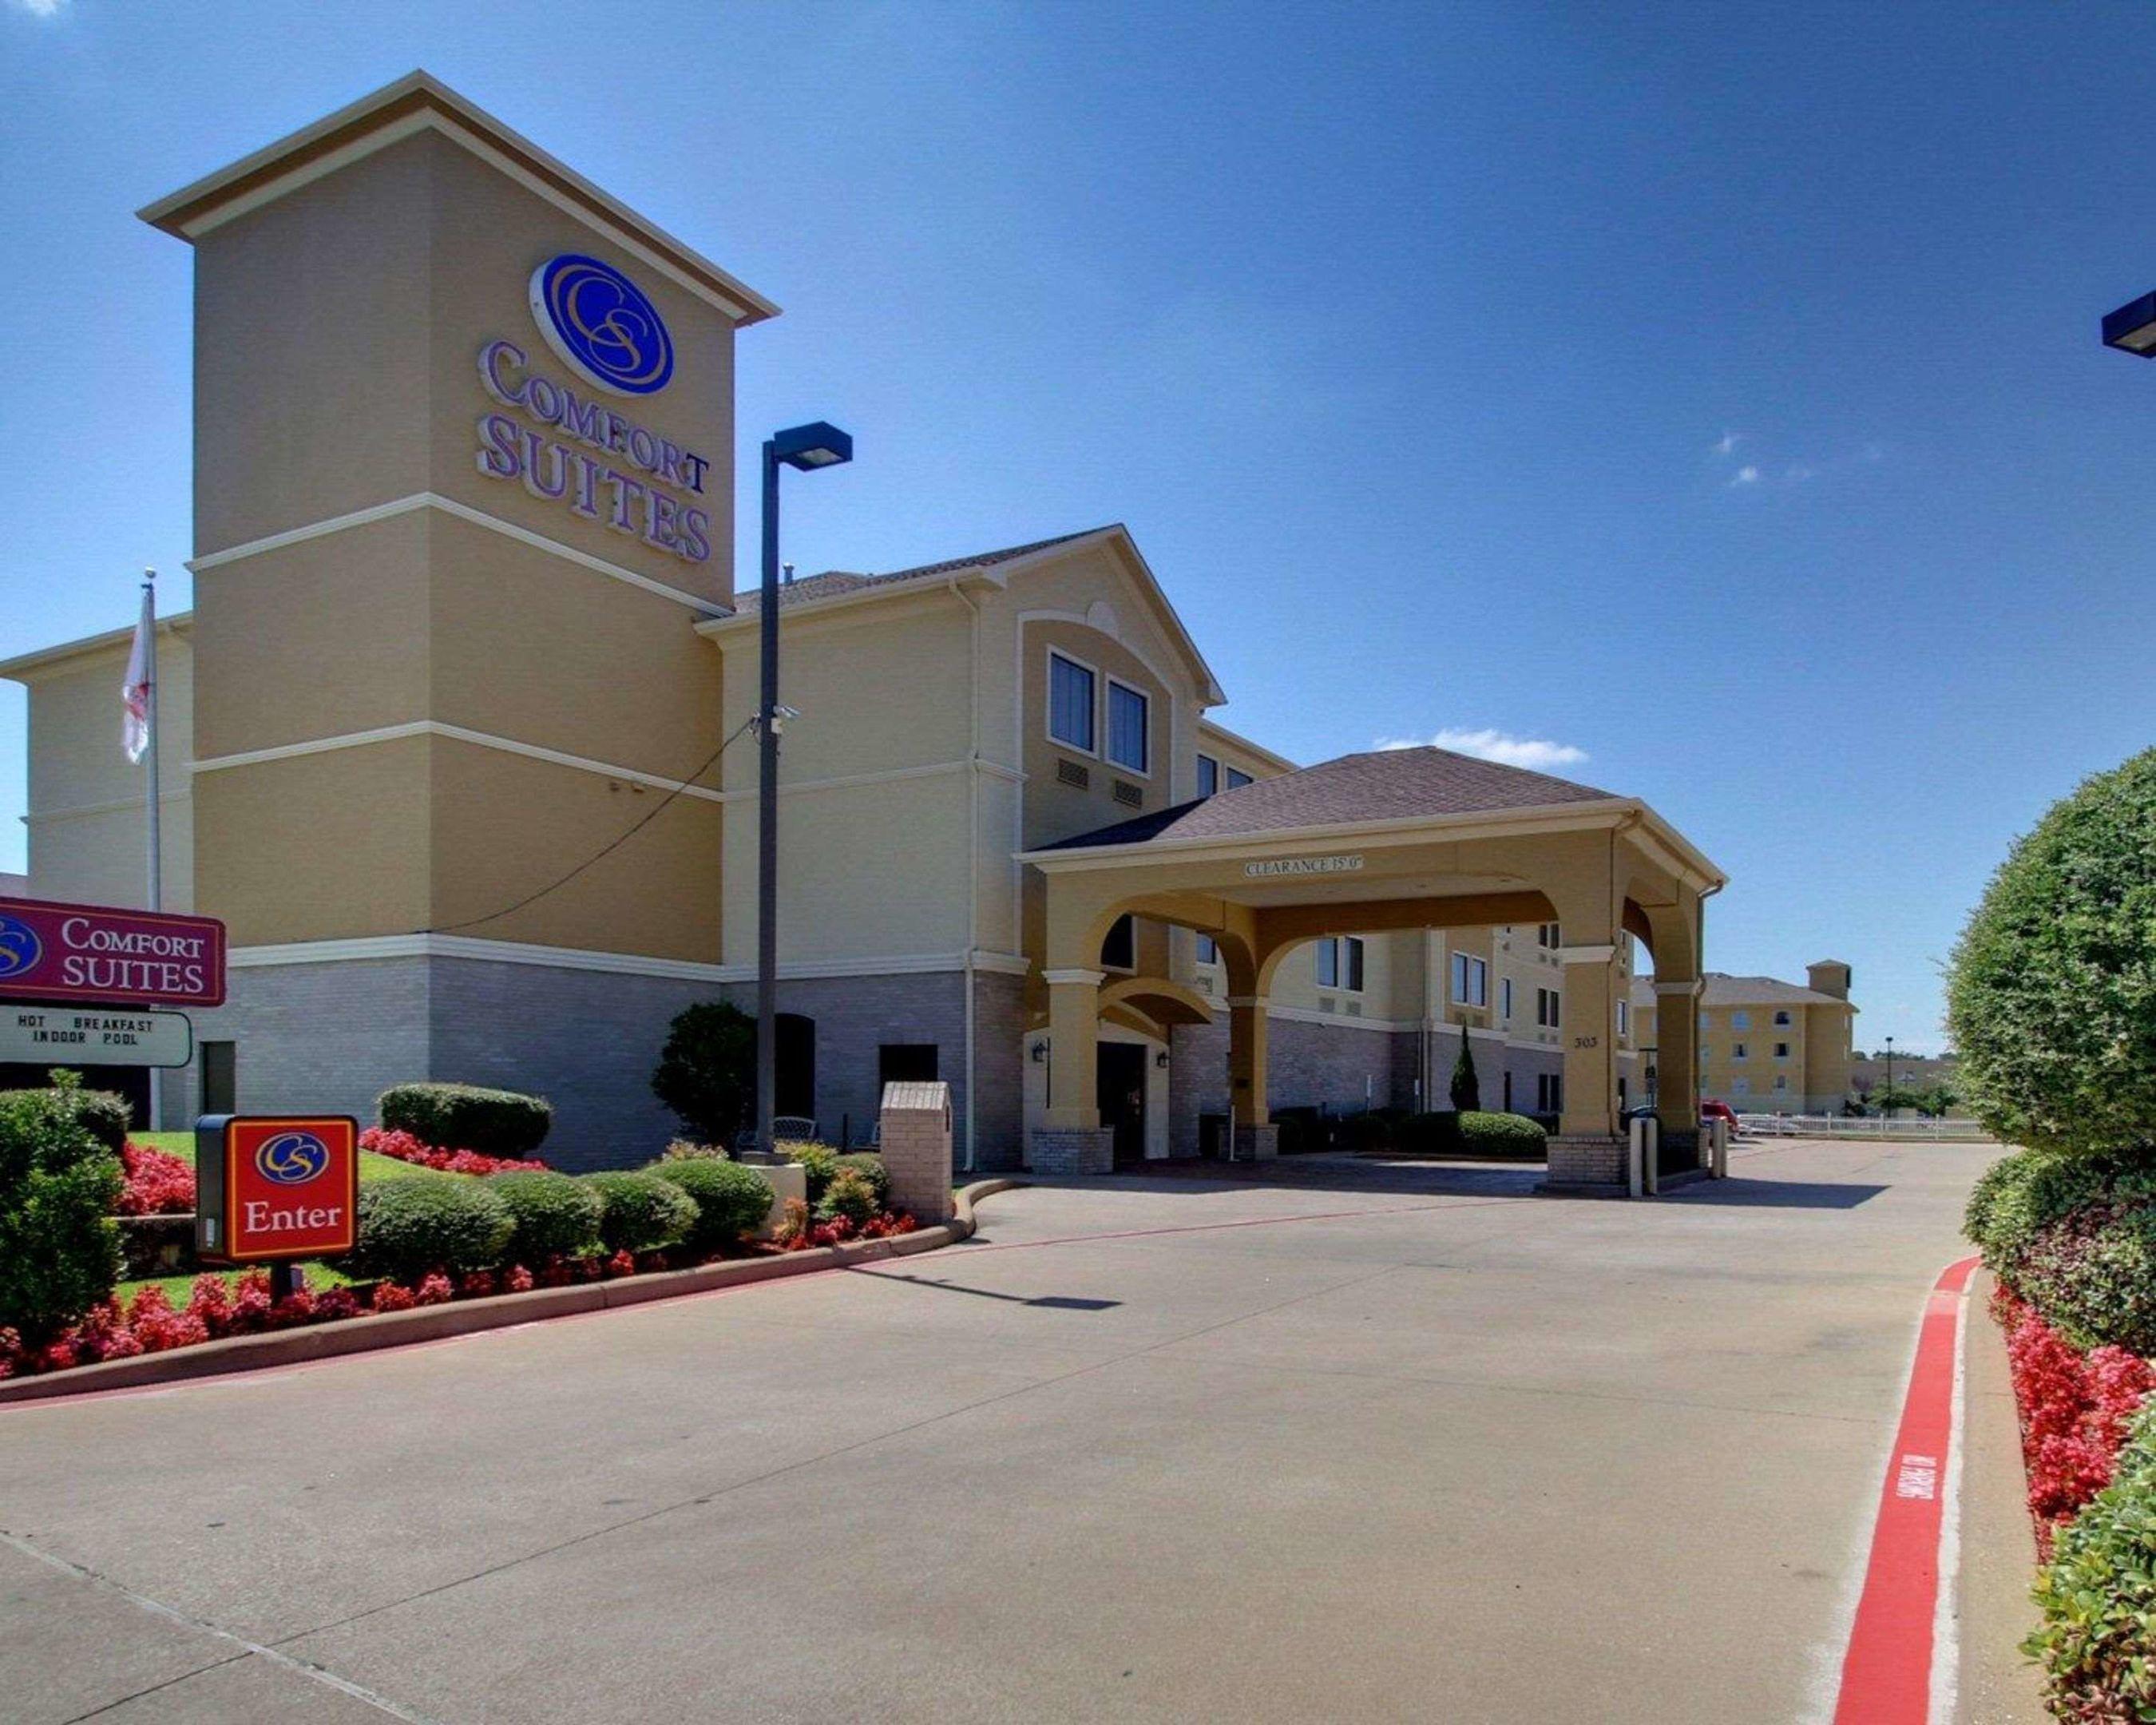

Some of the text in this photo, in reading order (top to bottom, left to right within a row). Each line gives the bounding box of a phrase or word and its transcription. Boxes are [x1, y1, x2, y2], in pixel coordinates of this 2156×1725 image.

[479, 413, 711, 561] SUITES
[1246, 859, 1328, 876] CLEARANCE
[61, 918, 204, 958] COMFORT
[61, 955, 204, 993] SUITES
[18, 1015, 153, 1033] HOT BREAKFAST
[33, 1031, 138, 1045] INDOOR POOL
[244, 1200, 343, 1233] Enter
